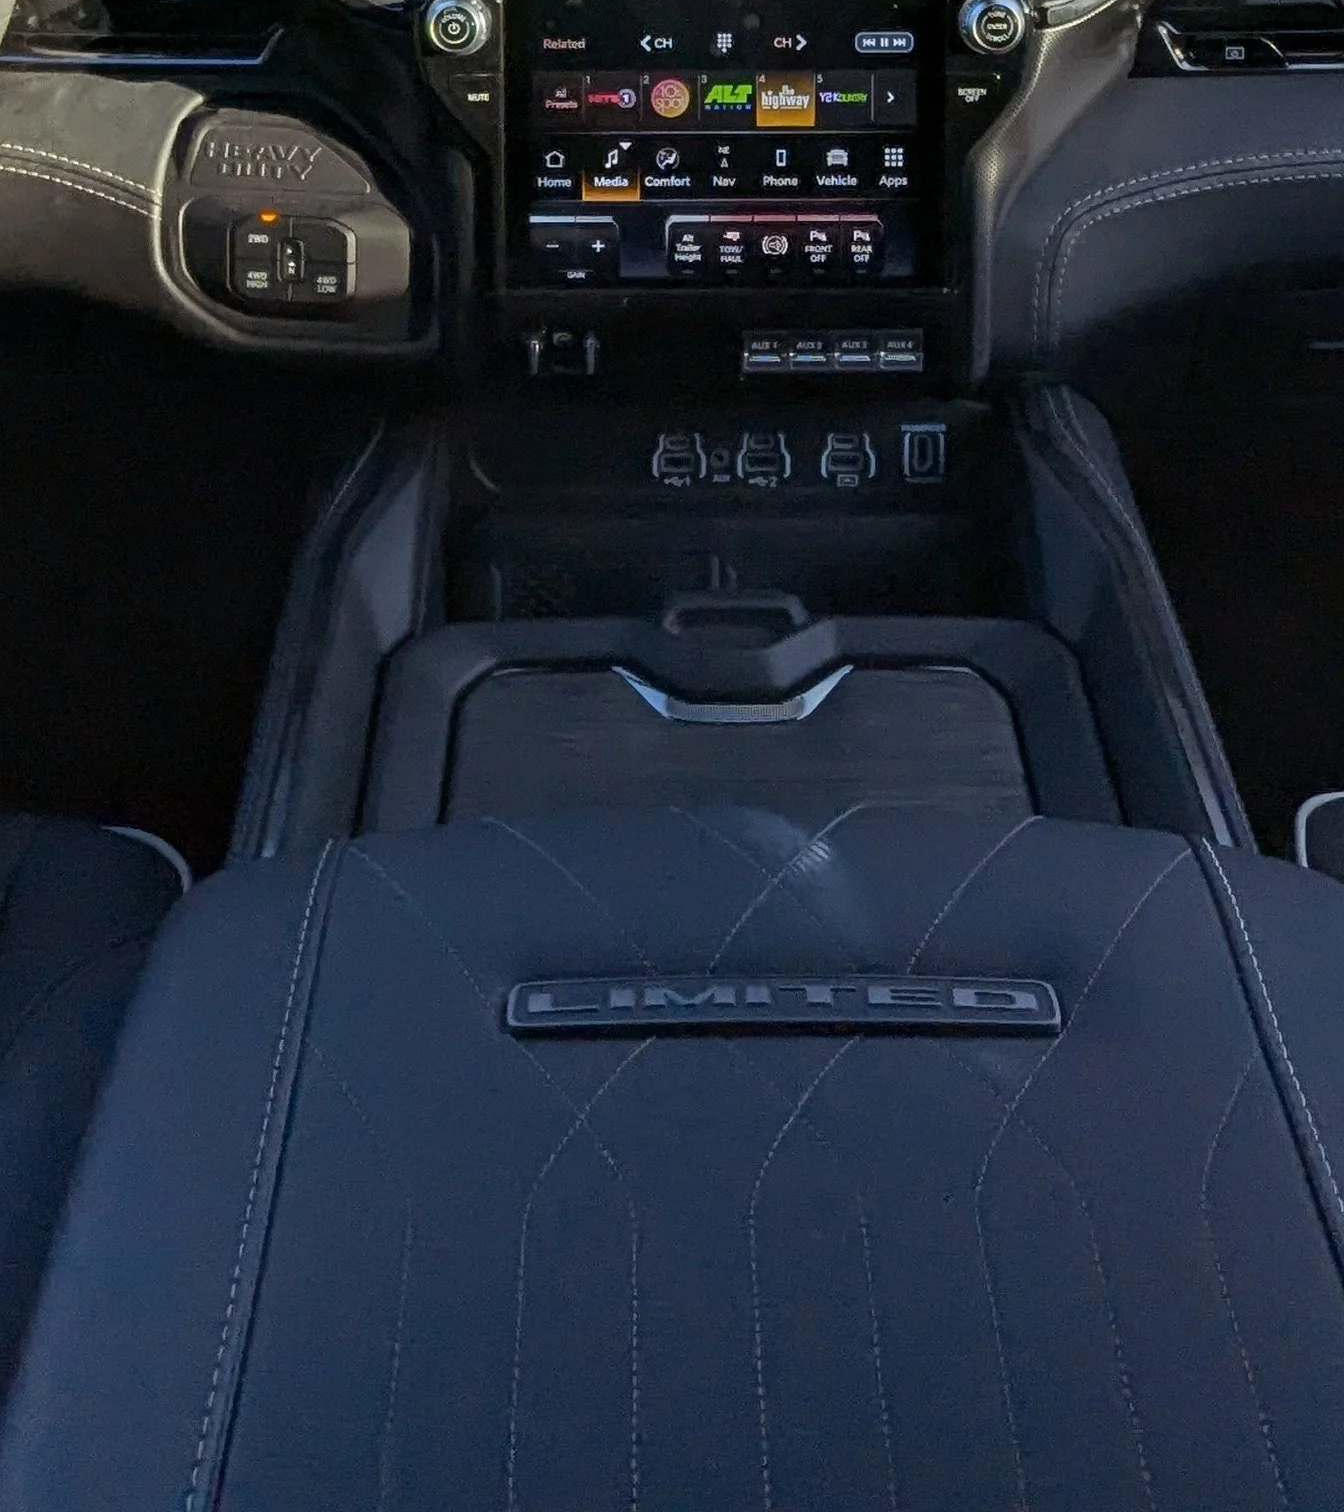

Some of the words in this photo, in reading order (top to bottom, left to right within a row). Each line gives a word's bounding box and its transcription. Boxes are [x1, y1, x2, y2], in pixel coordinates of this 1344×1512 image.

[543, 38, 586, 49] Related
[654, 37, 673, 49] CH
[773, 37, 792, 49] CH
[704, 84, 753, 104] ALT
[761, 90, 809, 110] highway
[537, 176, 572, 188] Home
[594, 175, 629, 187] Media
[644, 175, 691, 187] Comfort
[713, 175, 736, 187] Nav
[763, 175, 798, 187] Phone
[816, 174, 857, 186] Vehicle
[879, 175, 908, 188] Apps
[804, 244, 833, 253] FRONT
[850, 244, 873, 253] REAR
[810, 253, 827, 263] OFF
[853, 253, 870, 263] OFF
[246, 270, 268, 280] 4WD
[316, 275, 338, 285] 4WD
[751, 341, 770, 350] AUX
[796, 341, 817, 350] AUX
[842, 341, 861, 350] AUX
[887, 341, 906, 350] AUX
[527, 985, 1038, 1014] LIMITED
